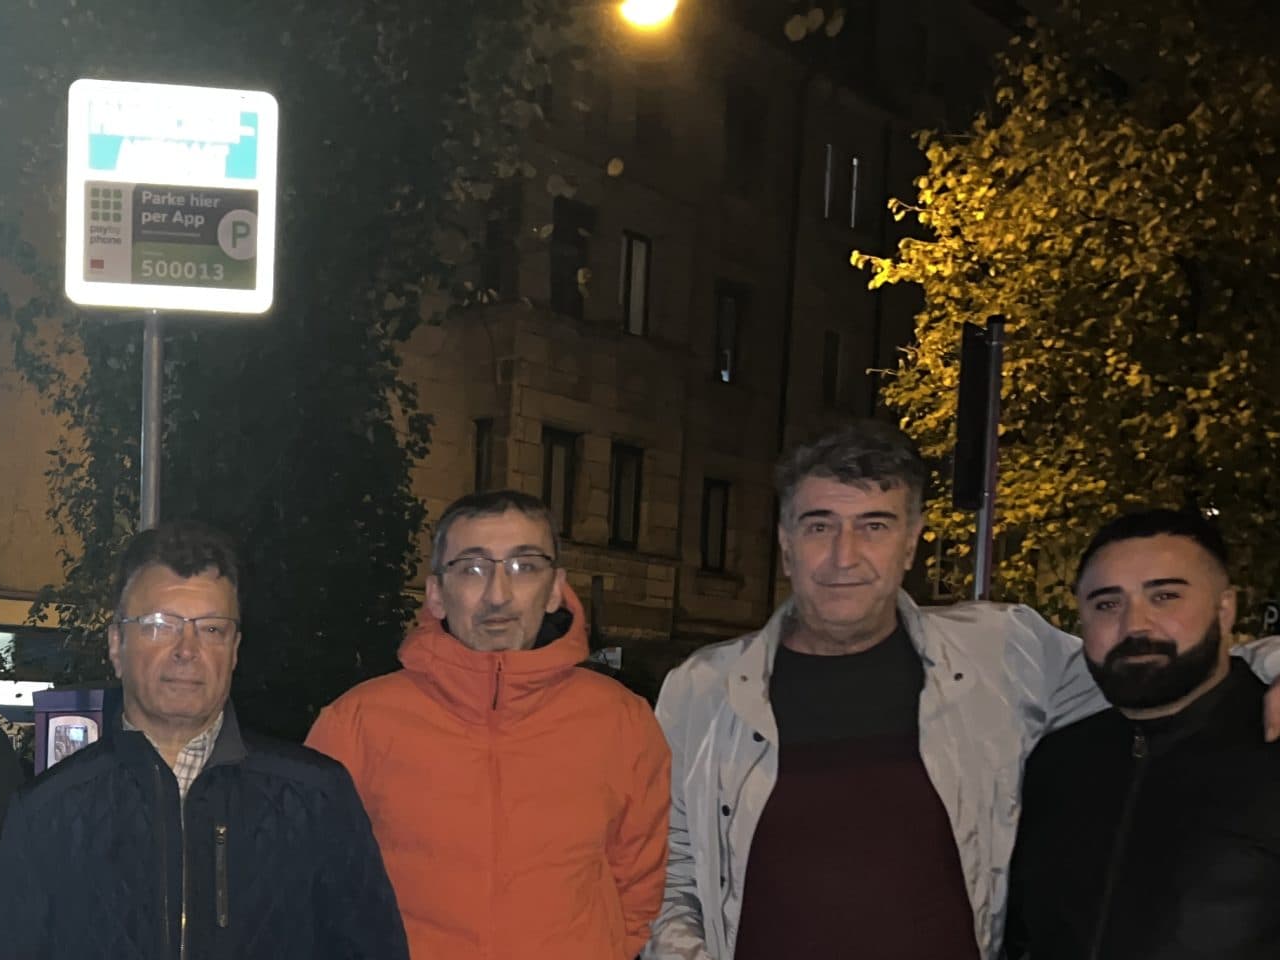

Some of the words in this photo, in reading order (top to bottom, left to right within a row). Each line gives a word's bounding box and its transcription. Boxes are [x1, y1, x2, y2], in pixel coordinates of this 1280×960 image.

[141, 190, 185, 206] Parke
[190, 193, 220, 208] hier
[141, 212, 168, 225] per
[172, 210, 205, 228] App
[231, 220, 251, 248] P
[141, 260, 224, 281] 500013
